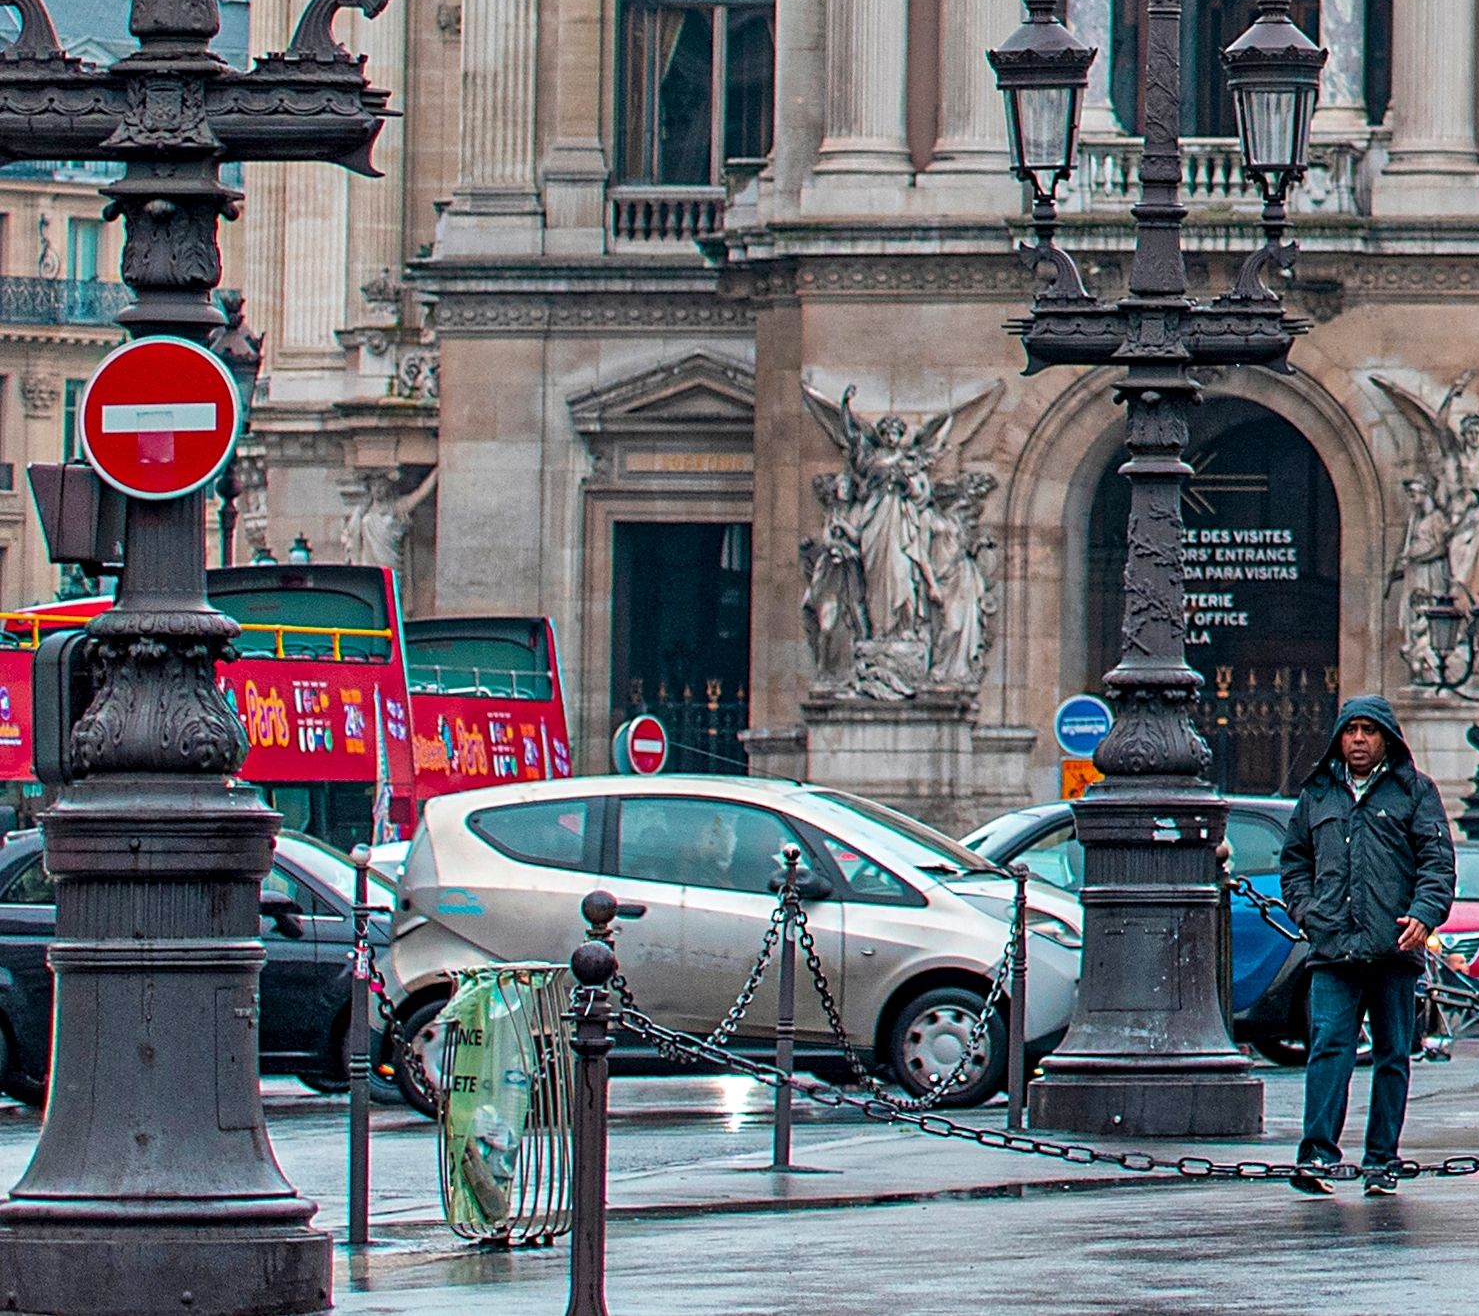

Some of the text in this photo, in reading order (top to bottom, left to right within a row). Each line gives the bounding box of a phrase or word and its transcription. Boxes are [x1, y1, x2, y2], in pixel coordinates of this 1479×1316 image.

[1200, 529, 1231, 544] DES
[1232, 529, 1293, 544] VISITES
[1214, 547, 1298, 563] ENTRANCE
[1205, 566, 1244, 581] PARA
[1244, 566, 1299, 581] VISITAS
[1193, 611, 1250, 627] OFFICE
